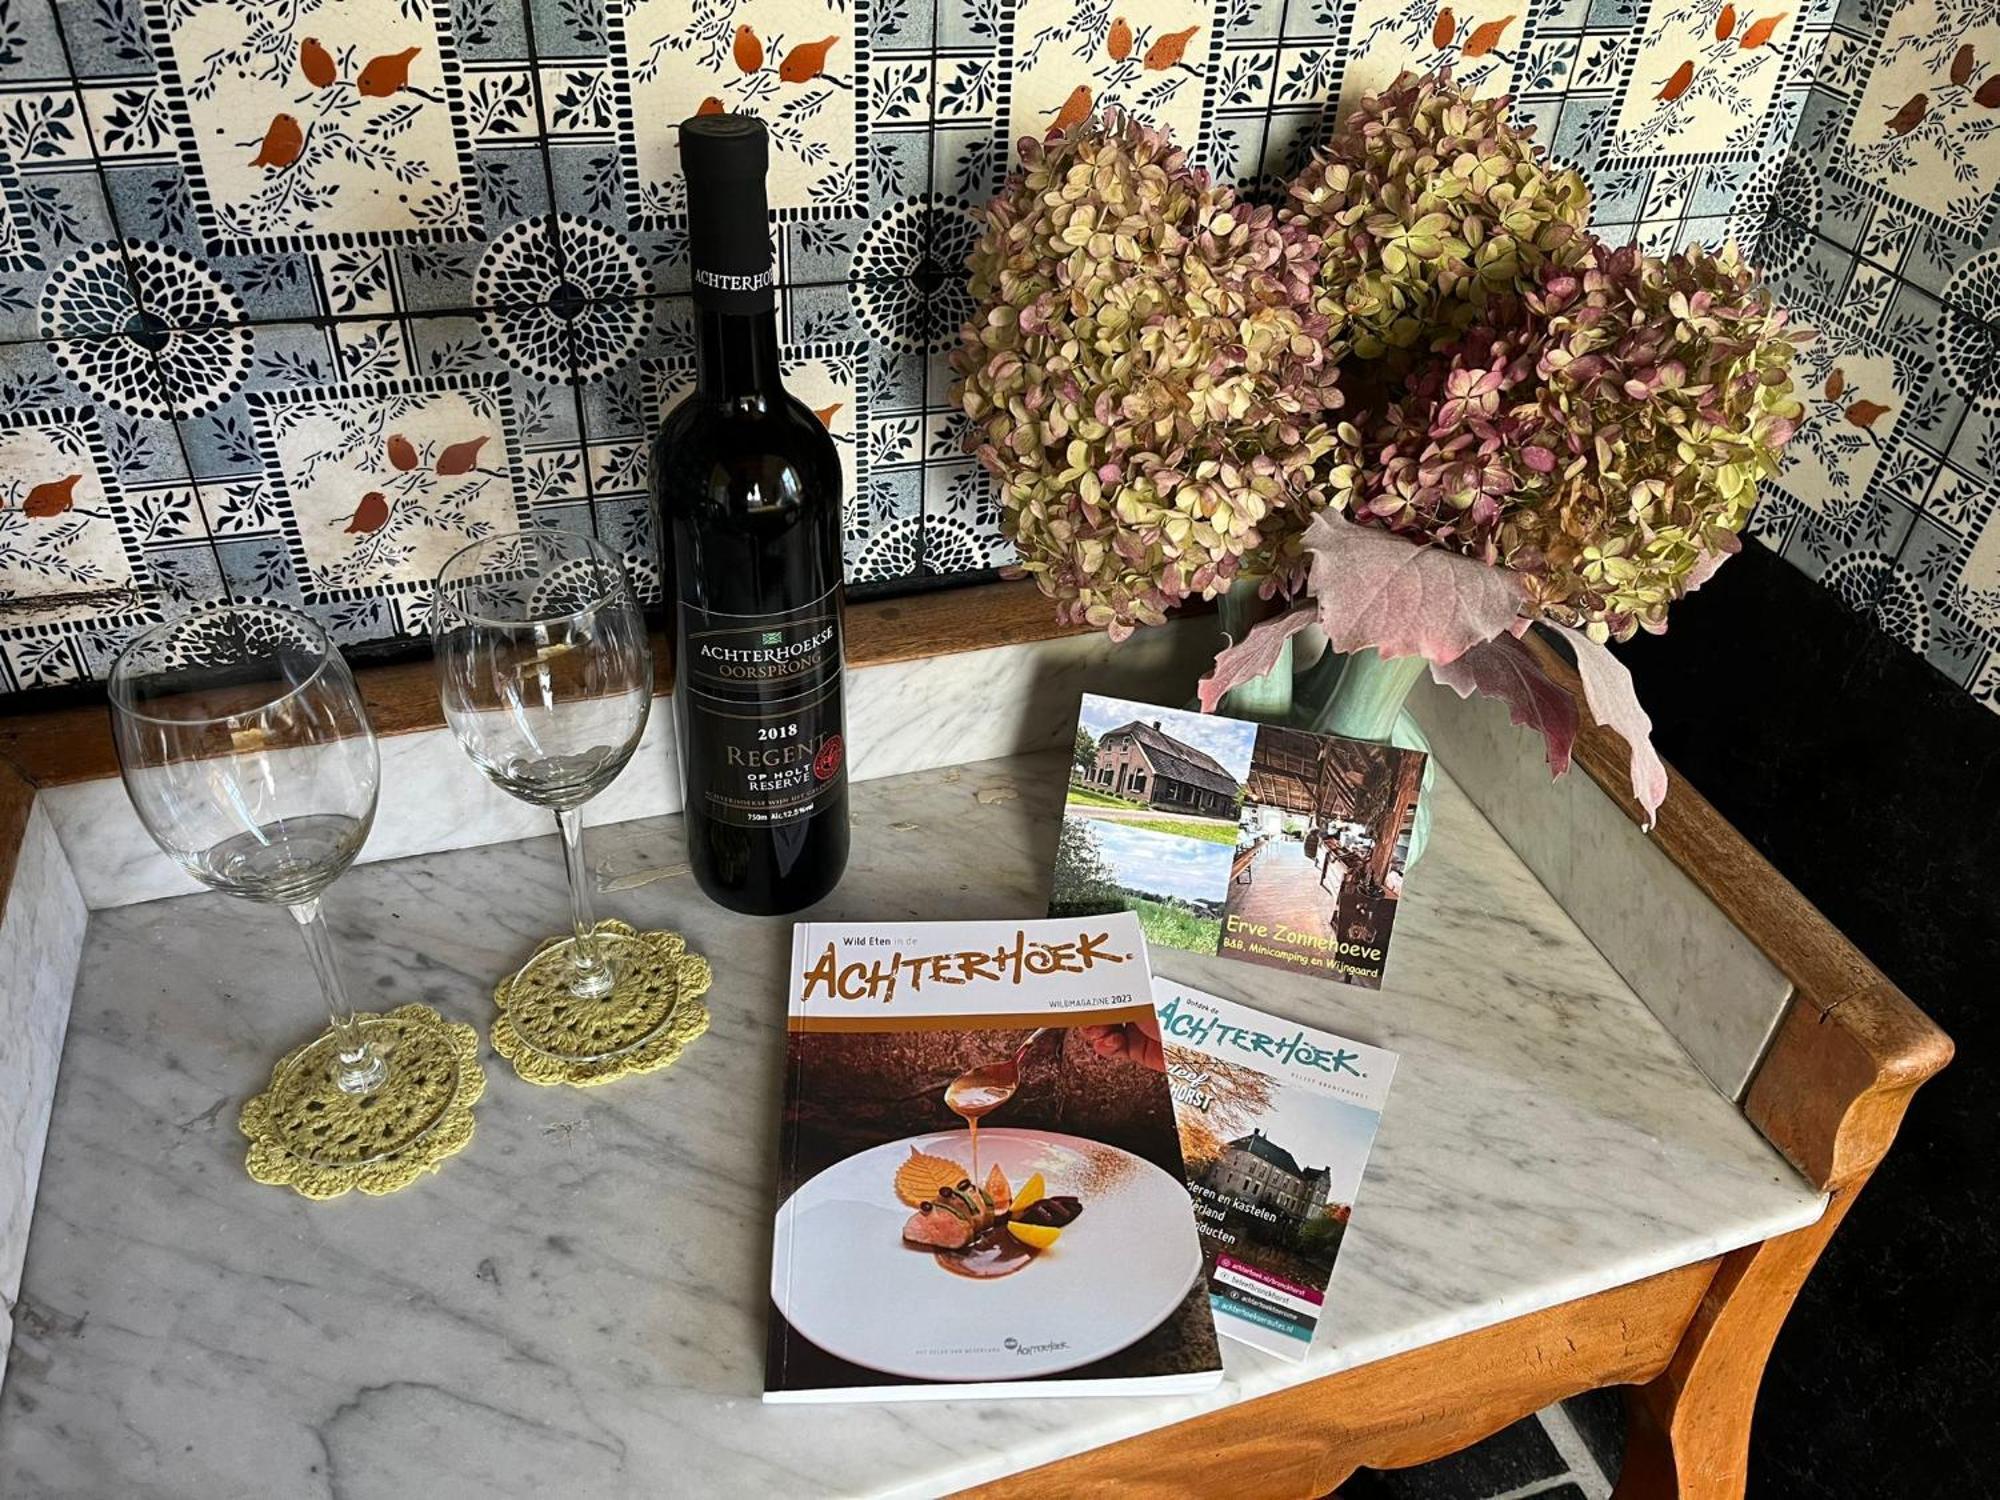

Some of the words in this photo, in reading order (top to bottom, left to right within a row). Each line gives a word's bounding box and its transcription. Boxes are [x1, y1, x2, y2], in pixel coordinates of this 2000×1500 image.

[701, 625, 833, 664] ACHTERHOEKSE
[719, 653, 821, 678] OORSPRONG
[758, 723, 798, 741] 2018
[747, 773, 767, 781] OP
[774, 763, 811, 779] HOLT
[749, 773, 810, 791] RESERVE
[844, 936, 867, 946] Wild
[869, 936, 891, 946] Eten
[1227, 915, 1268, 937] Erve
[1273, 924, 1381, 961] Zonnehoeve
[1223, 937, 1246, 952] B&B,
[1249, 944, 1309, 966] Minicamping
[1310, 958, 1324, 967] en
[1326, 959, 1379, 979] Wijngaard
[1049, 998, 1110, 1009] WILDMAGAZINE
[1111, 994, 1133, 1005] 2023
[1167, 1064, 1209, 1088] leef
[1170, 1083, 1213, 1110] HORST
[1187, 1181, 1219, 1200] deren
[1218, 1193, 1231, 1206] en
[1233, 1198, 1277, 1223] kastelen
[1191, 1200, 1226, 1222] erland
